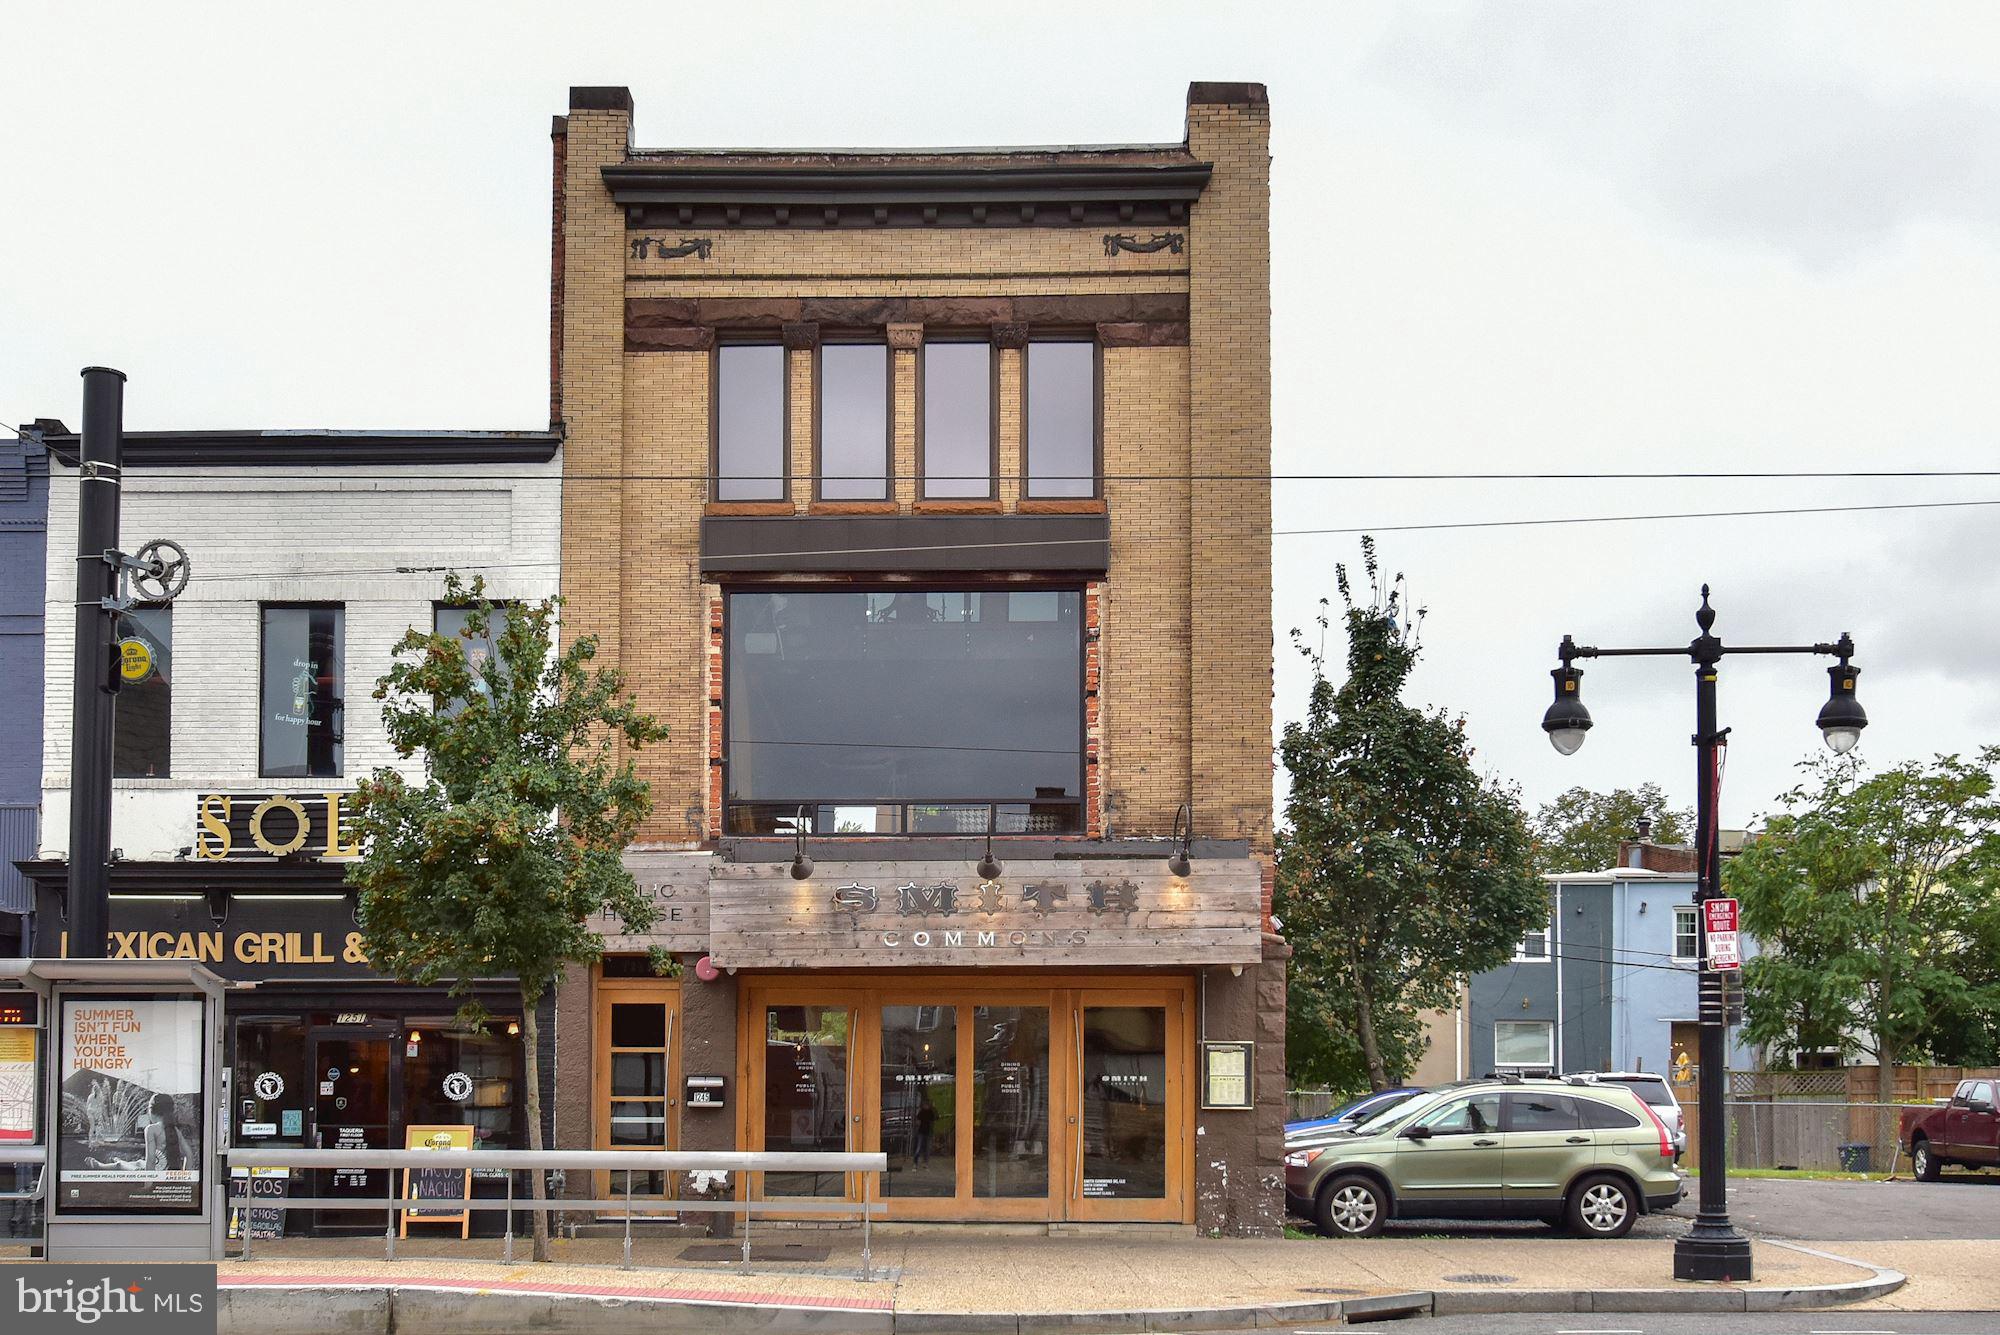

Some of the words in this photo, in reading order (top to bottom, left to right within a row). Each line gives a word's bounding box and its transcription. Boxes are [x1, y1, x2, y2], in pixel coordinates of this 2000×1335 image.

[293, 659, 310, 669] drop
[311, 661, 318, 669] in
[275, 713, 284, 721] for
[286, 715, 305, 726] happy
[306, 718, 322, 726] hour
[199, 793, 359, 860] SOL
[830, 881, 1139, 917] SMITH
[1710, 903, 1730, 913] SNOW
[1709, 912, 1734, 920] EMERGENCY
[1712, 920, 1731, 931] ROUTE
[884, 930, 1088, 947] COMMONS
[1710, 934, 1717, 942] NO
[1717, 933, 1735, 942] PARKING
[234, 932, 335, 963] GRILL
[343, 932, 370, 963] &
[1715, 944, 1731, 952] DURING
[74, 1009, 134, 1021] SUMMER
[337, 1013, 367, 1024] 1251
[74, 1021, 109, 1033] ISN'T
[112, 1021, 141, 1033] FUN
[74, 1033, 118, 1045] WHEN
[73, 1046, 125, 1057] YOU'RE
[73, 1058, 133, 1069] HUNGRY
[694, 1092, 710, 1102] 1245
[424, 1138, 451, 1148] Corona
[419, 1180, 463, 1198] NACHOS
[240, 1209, 279, 1220] NCHOS
